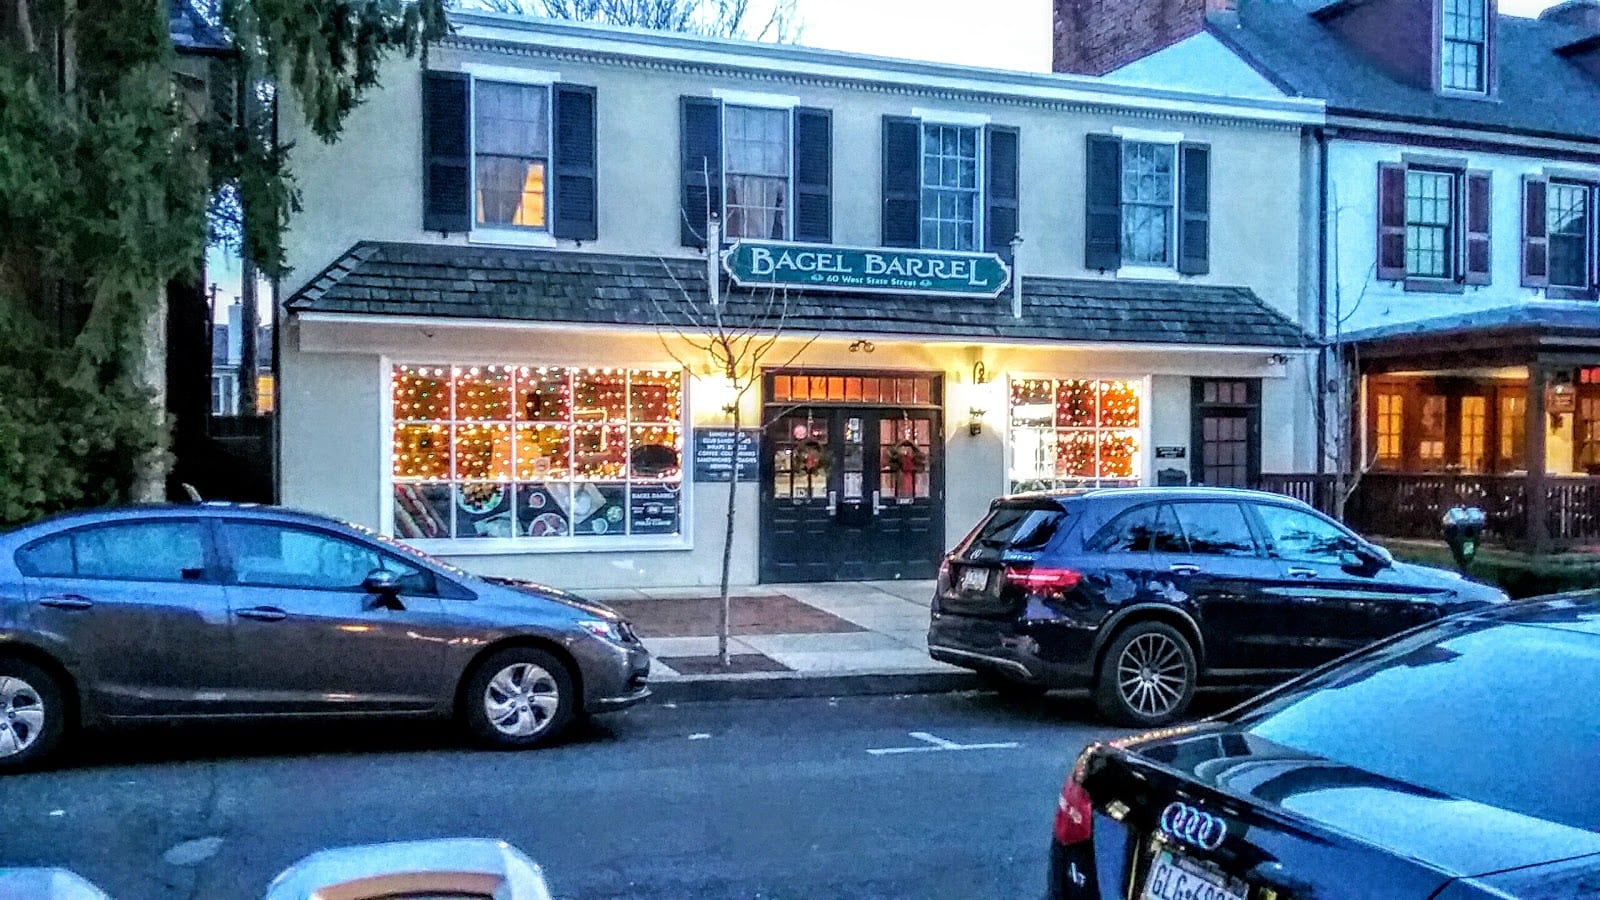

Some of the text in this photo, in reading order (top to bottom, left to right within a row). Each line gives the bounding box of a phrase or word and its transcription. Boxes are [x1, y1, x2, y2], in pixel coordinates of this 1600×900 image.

[750, 247, 988, 287] BAGEL BARREL
[826, 273, 917, 287] 60 West State Street
